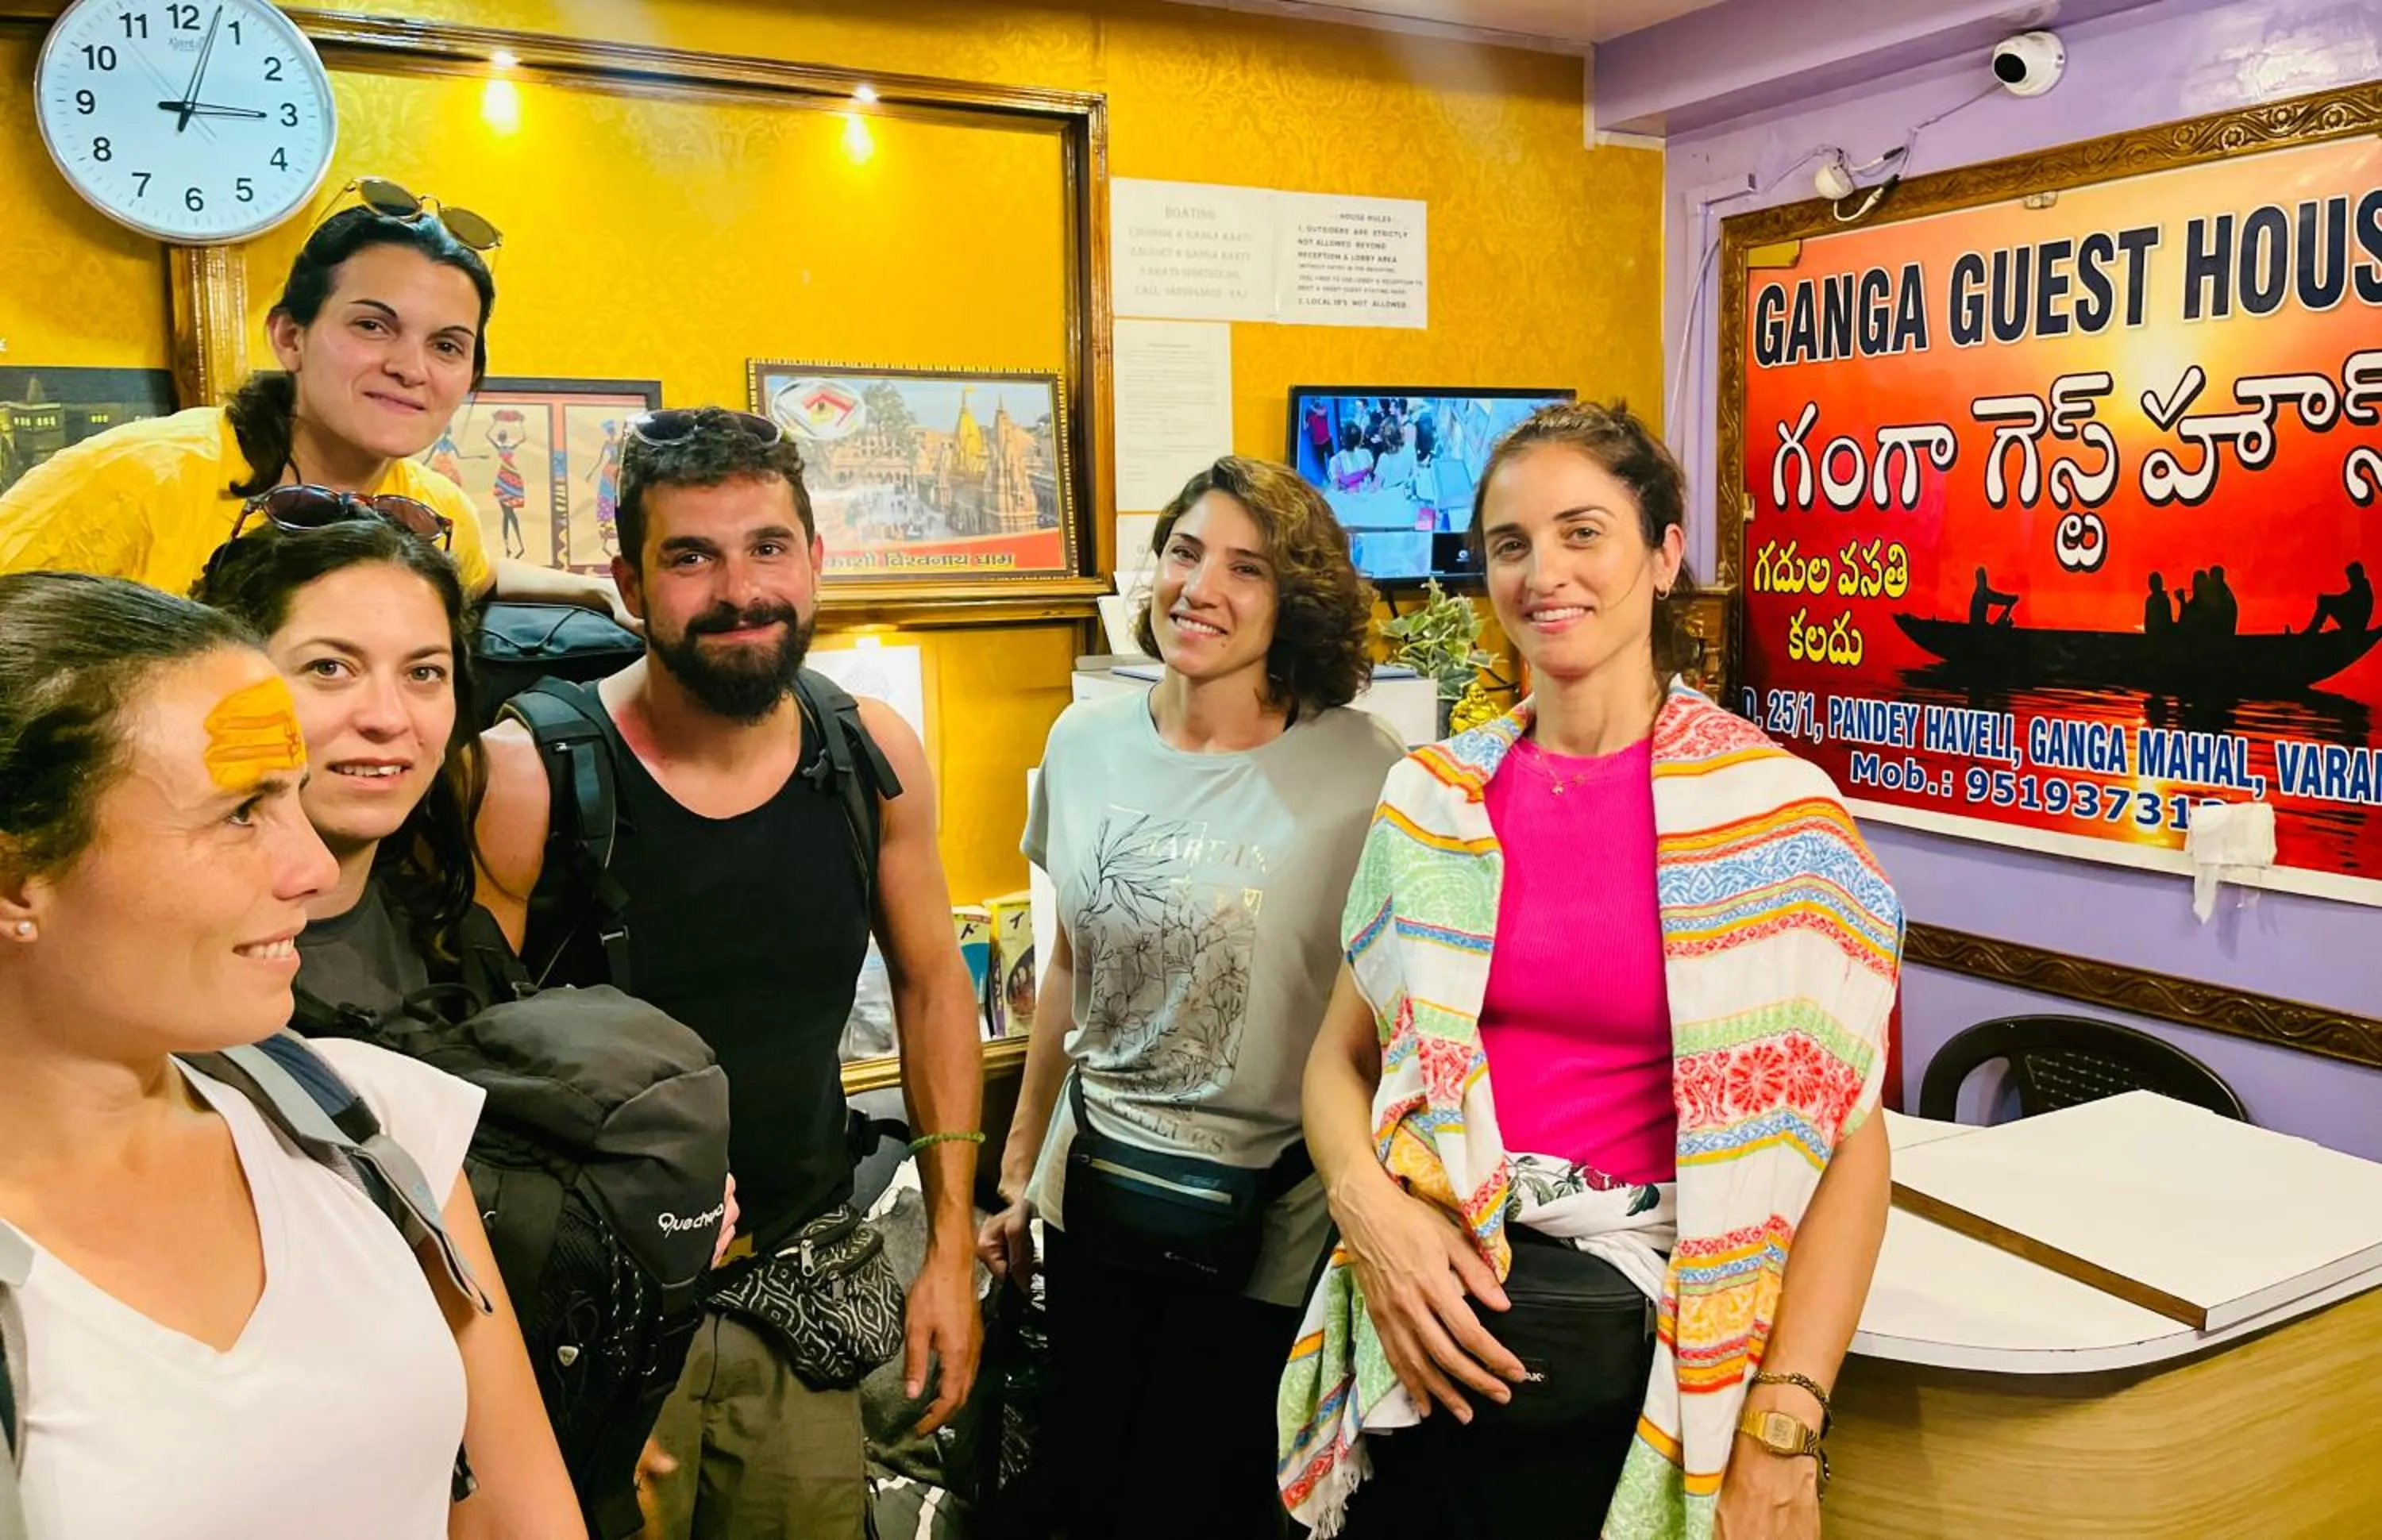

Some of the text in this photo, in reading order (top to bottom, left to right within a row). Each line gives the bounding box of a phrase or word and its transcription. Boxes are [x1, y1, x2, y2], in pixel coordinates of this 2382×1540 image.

[119, 13, 148, 39] 11
[167, 6, 200, 30] 12
[228, 20, 241, 45] 1
[82, 44, 117, 71] 10
[264, 56, 283, 81] 2
[75, 89, 95, 114] 9
[280, 103, 298, 127] 3
[93, 137, 111, 161] 8
[269, 147, 288, 171] 4
[132, 172, 152, 197] 7
[236, 178, 253, 202] 5
[185, 187, 204, 212] 6
[1754, 263, 1928, 368] GANGA
[1948, 225, 2160, 348] GUEST
[1771, 402, 1958, 511] గంగా
[1971, 372, 2119, 572] గెస్ట్
[1753, 537, 1908, 598] గదుల వసతి
[1789, 606, 1863, 666] కలదు
[1767, 689, 1823, 744] 25/1,
[1829, 696, 1918, 748] PANDEY
[1925, 707, 2021, 769] HAVELI,
[2029, 715, 2128, 776] GANGA
[2137, 728, 2265, 799] MAHAL,
[1851, 751, 2227, 832] Mob.: 95193731
